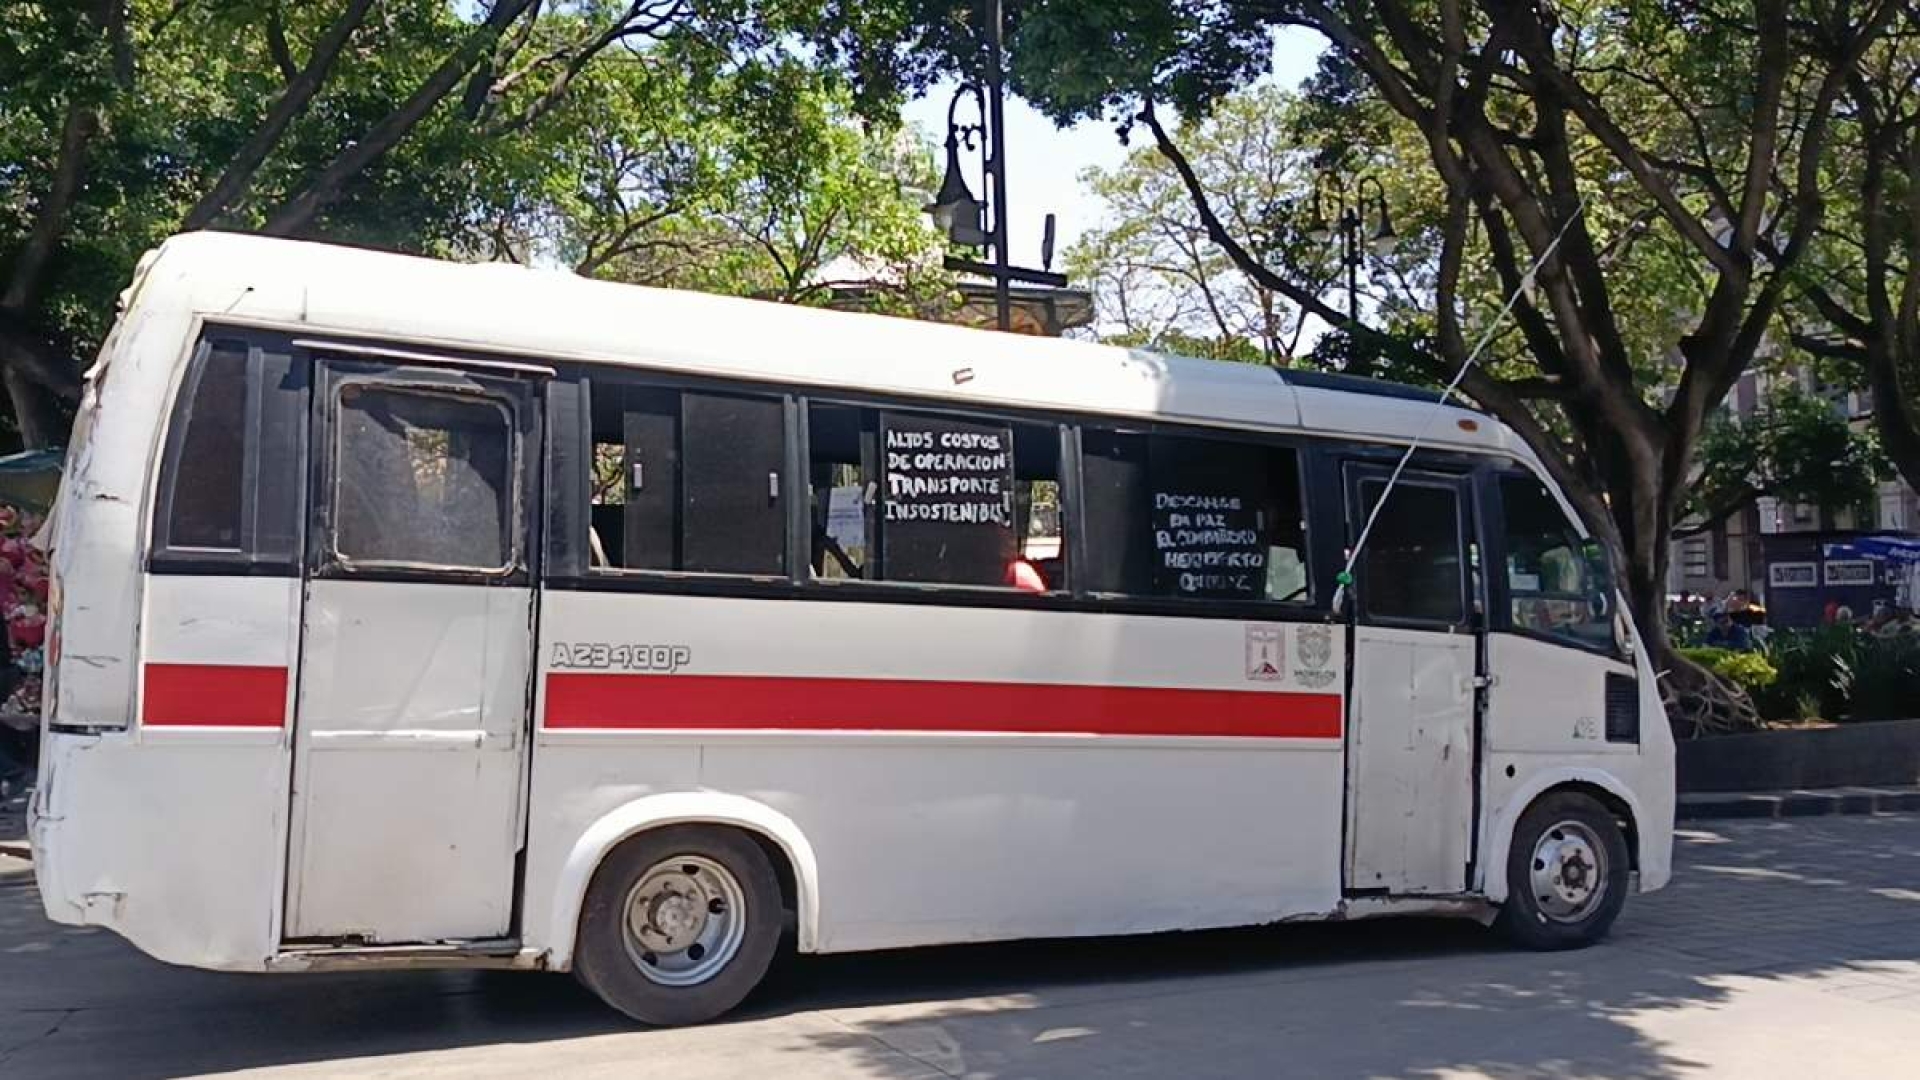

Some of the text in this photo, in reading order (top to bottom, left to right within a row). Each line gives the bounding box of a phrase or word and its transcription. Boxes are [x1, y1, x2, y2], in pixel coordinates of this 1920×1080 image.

[887, 429, 1000, 450] ALTOS COSTOS
[887, 452, 1006, 470] DE OPERACION
[887, 472, 1000, 498] TRANSPORTE
[1196, 513, 1227, 528] PAZ
